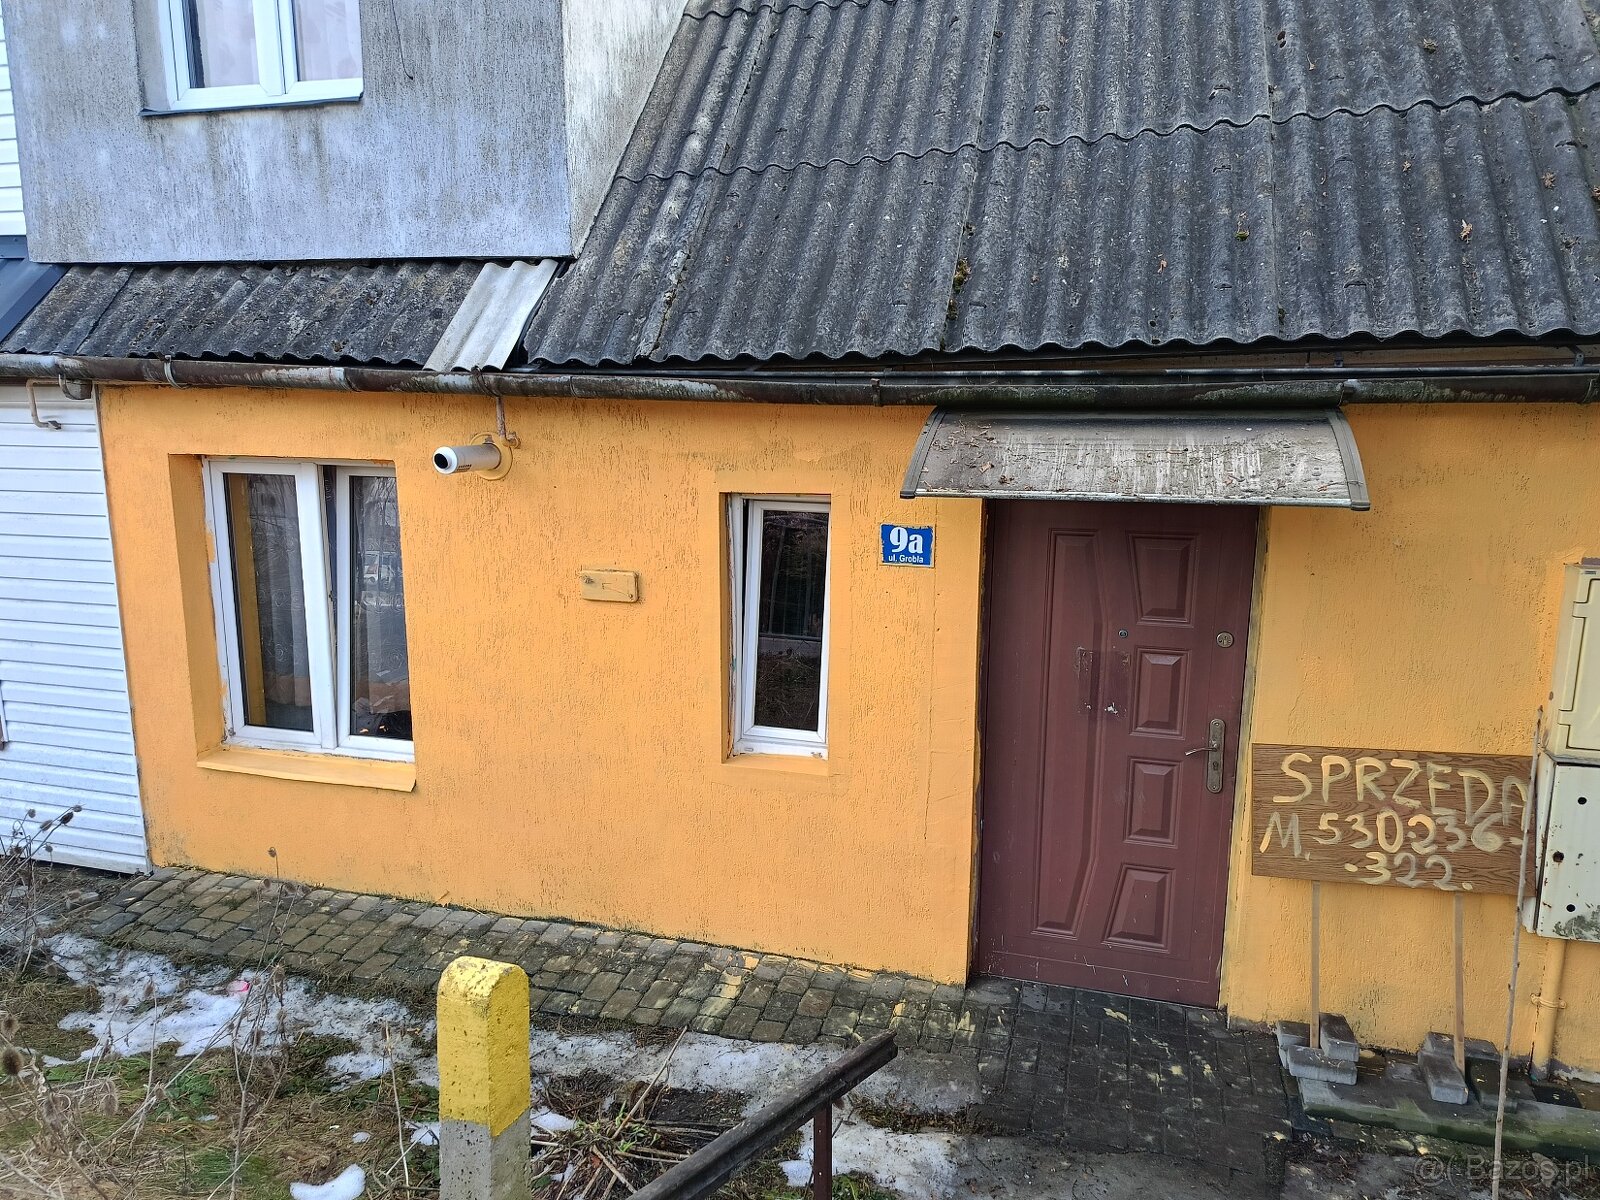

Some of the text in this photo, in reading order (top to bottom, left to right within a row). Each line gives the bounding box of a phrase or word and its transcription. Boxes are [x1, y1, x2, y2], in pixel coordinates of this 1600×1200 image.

[889, 526, 923, 553] 9a
[888, 554, 924, 563] ul. Grobla
